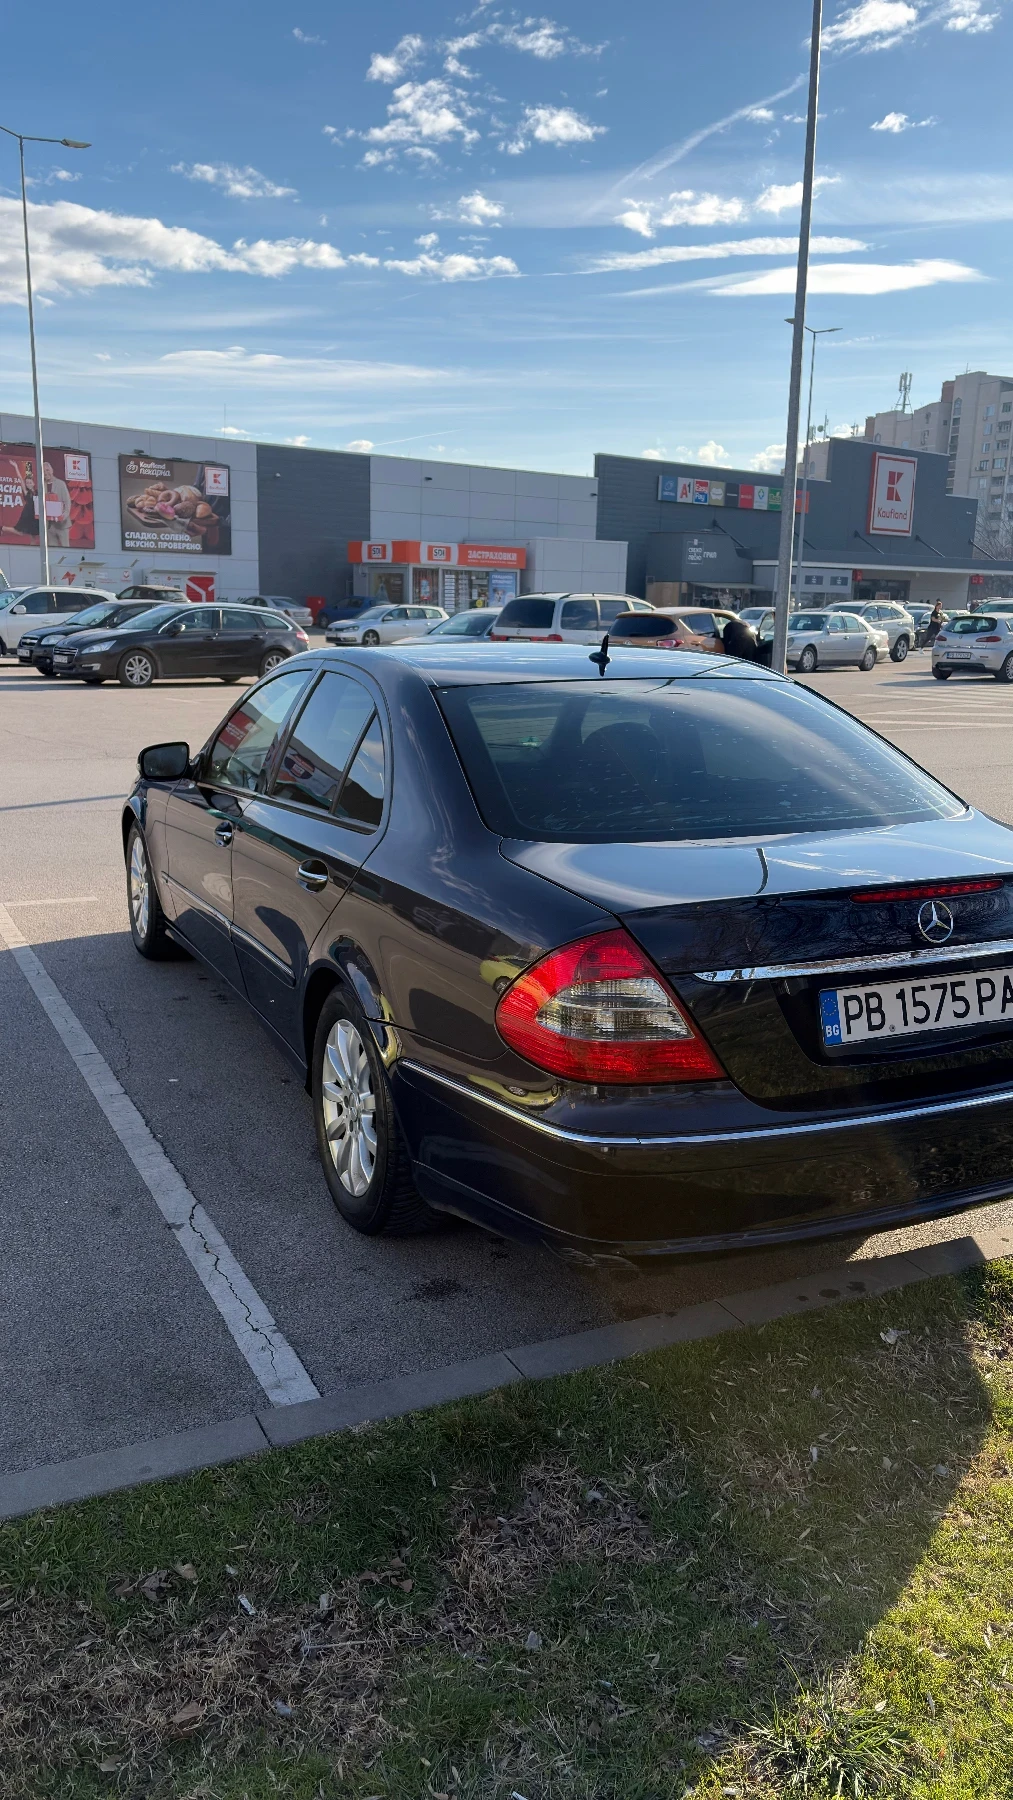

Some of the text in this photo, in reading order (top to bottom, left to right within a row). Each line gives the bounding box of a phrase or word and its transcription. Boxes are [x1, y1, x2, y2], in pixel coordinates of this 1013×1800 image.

[139, 461, 166, 470] Kaufland
[139, 467, 171, 478] пекарна
[695, 483, 708, 493] Easy
[695, 492, 706, 502] Pay
[877, 507, 907, 520] Kaufland
[124, 531, 192, 542] СЛАДКО. СОЛЕНО.
[124, 540, 203, 551] ВКУСНО. ПРОВЕРЕНО.
[433, 548, 445, 557] SDI
[467, 550, 518, 561] ЗАСТРАХОВКИ
[843, 991, 887, 1035] PB
[895, 980, 971, 1028] 1575
[825, 1024, 840, 1038] BG
